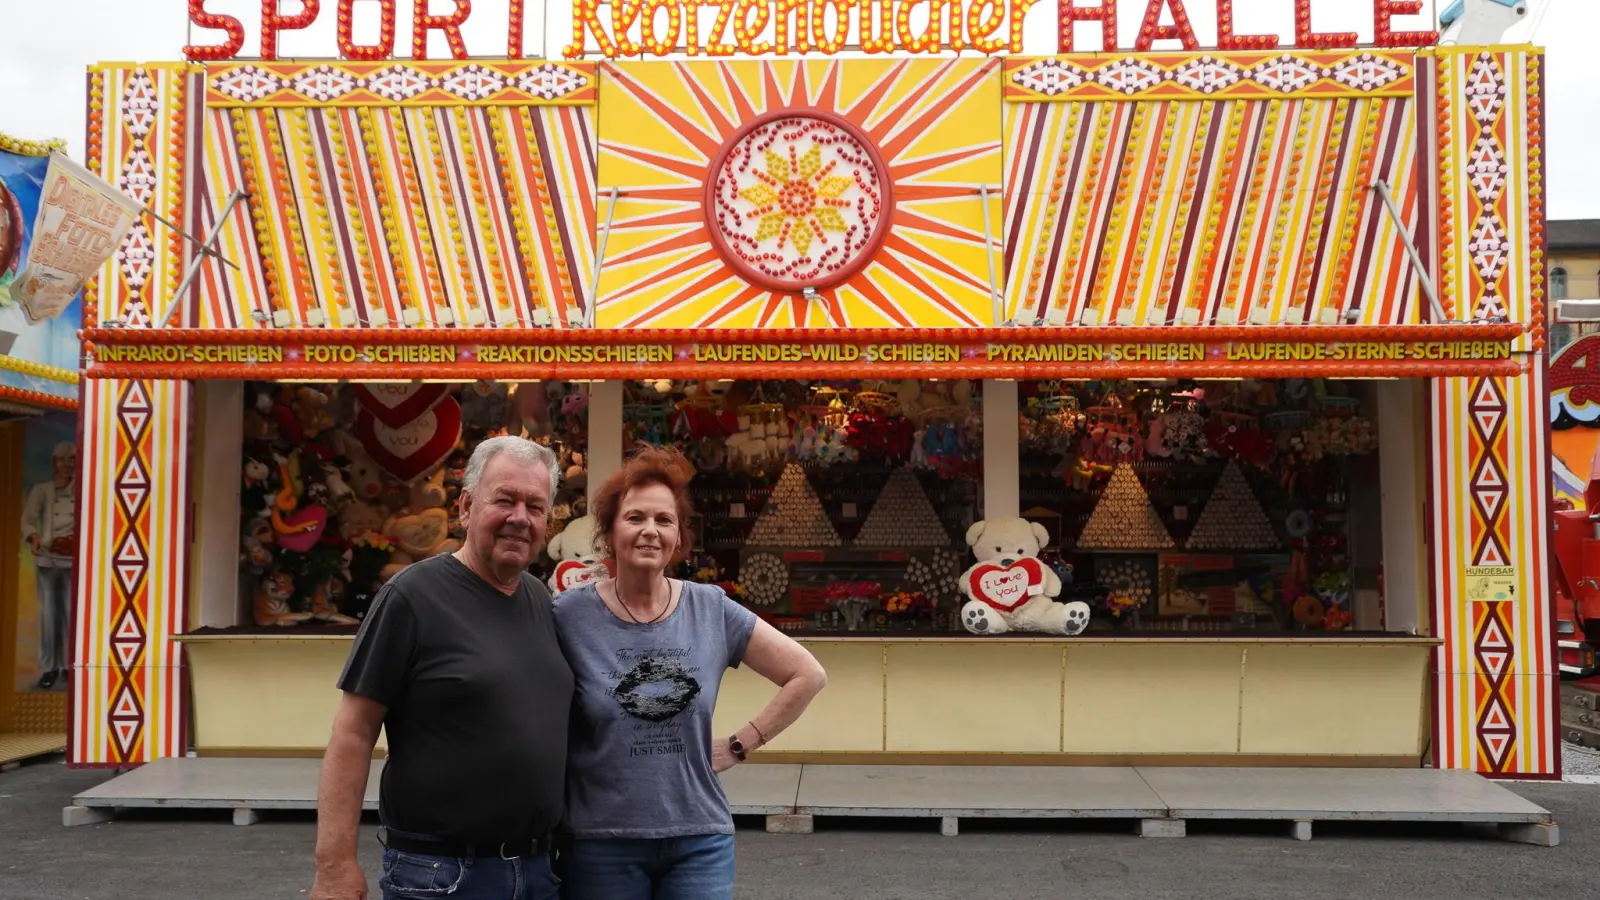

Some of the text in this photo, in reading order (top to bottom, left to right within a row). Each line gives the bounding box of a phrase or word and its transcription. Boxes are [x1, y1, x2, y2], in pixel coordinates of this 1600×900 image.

[1057, 0, 1439, 53] HALLE
[1466, 567, 1514, 575] HUNDEBAR
[984, 573, 1022, 589] I Lve
[615, 648, 633, 664] The
[629, 744, 687, 757] JUST SMILE
